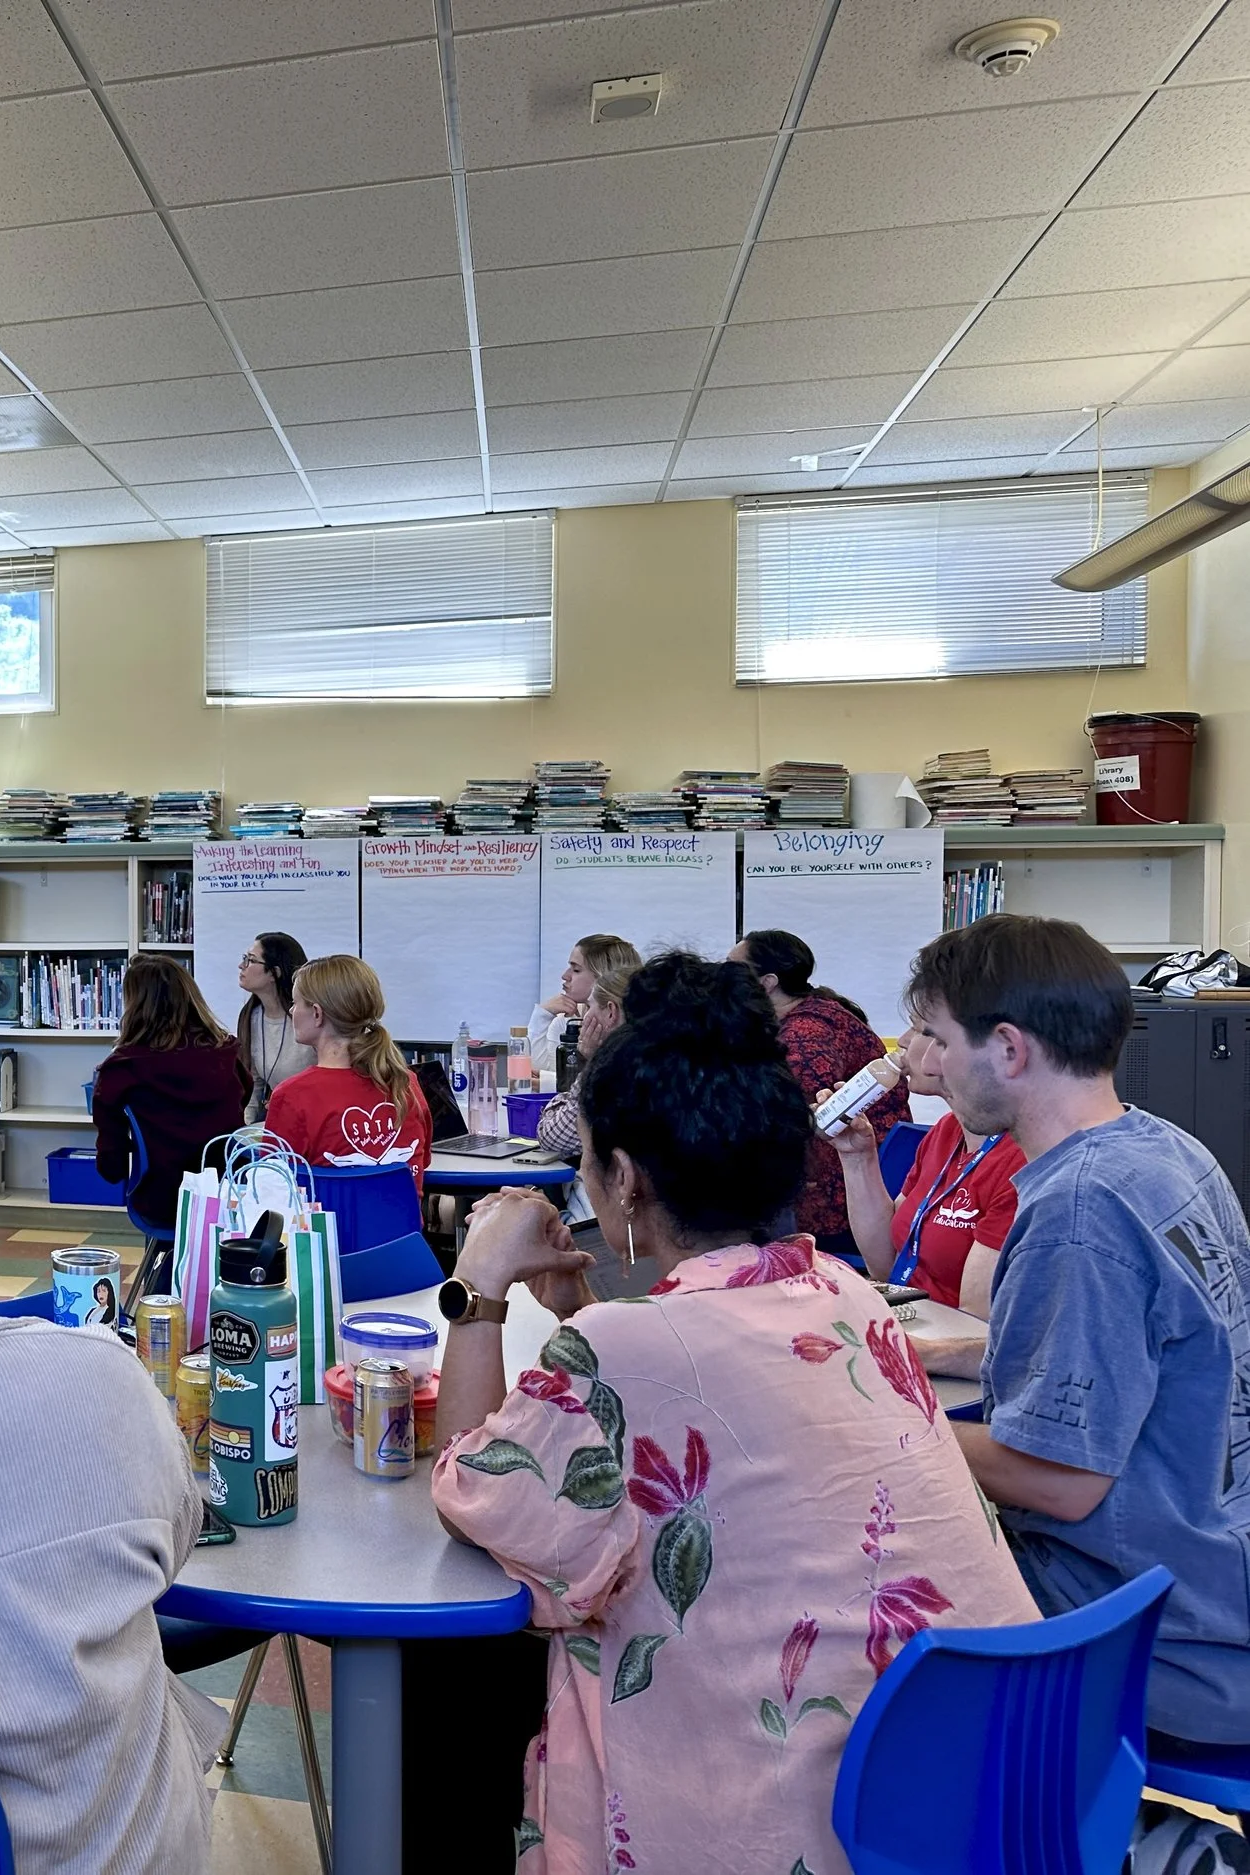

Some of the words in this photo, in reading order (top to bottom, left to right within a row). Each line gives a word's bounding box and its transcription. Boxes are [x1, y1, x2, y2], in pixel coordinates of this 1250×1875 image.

[365, 841, 411, 854] Growth
[415, 839, 462, 855] Mindset
[477, 839, 538, 861] Resiliency
[550, 835, 602, 855] Safety
[610, 835, 634, 849] and
[642, 835, 700, 855] Respect
[773, 831, 884, 856] Belonging
[194, 845, 235, 859] Making
[255, 844, 303, 860] Learning
[577, 855, 623, 863] STUDENTS
[208, 858, 275, 873] Interesting
[279, 859, 296, 869] and
[297, 858, 321, 869] Fun
[769, 865, 785, 873] YOU
[791, 865, 802, 873] BE
[810, 863, 854, 872] YOURSELF
[859, 862, 882, 870] WITH
[933, 1215, 976, 1229] Educators
[211, 1328, 252, 1347] LOMA
[214, 1343, 247, 1353] BREWING
[215, 1444, 251, 1459] OBISPO
